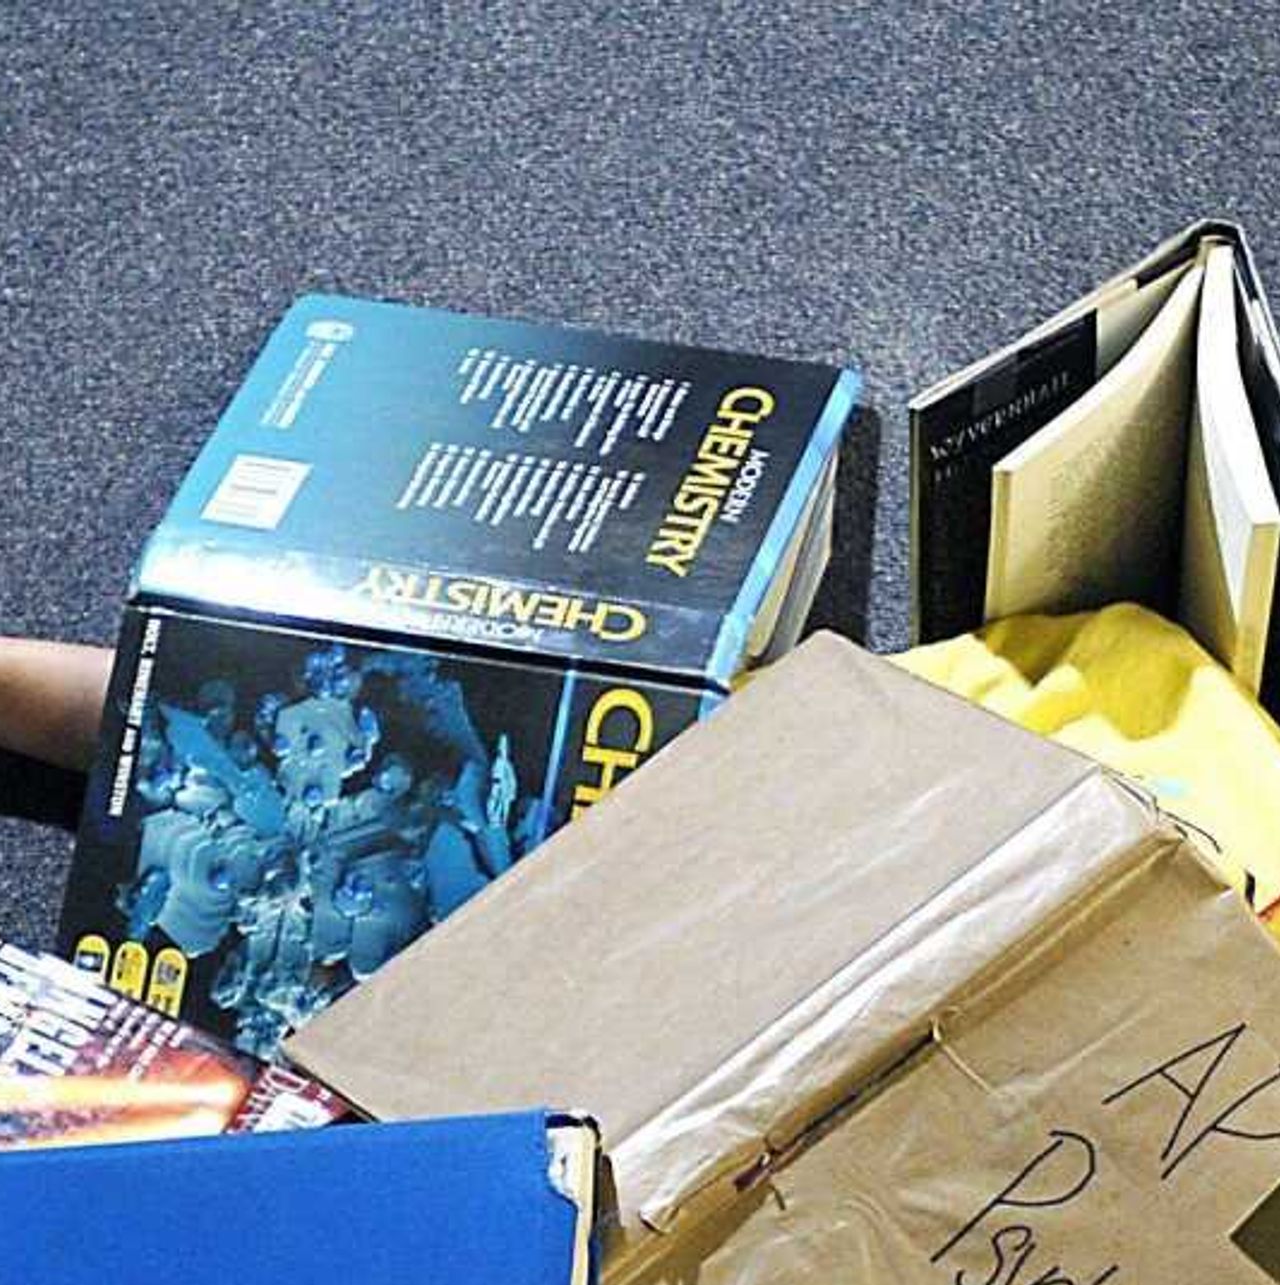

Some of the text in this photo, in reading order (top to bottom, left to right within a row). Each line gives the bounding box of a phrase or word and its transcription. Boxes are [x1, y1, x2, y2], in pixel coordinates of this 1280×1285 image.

[644, 386, 775, 577] CHEMISTRY
[720, 447, 772, 523] MODERN
[356, 564, 648, 642] CHEMISTRY
